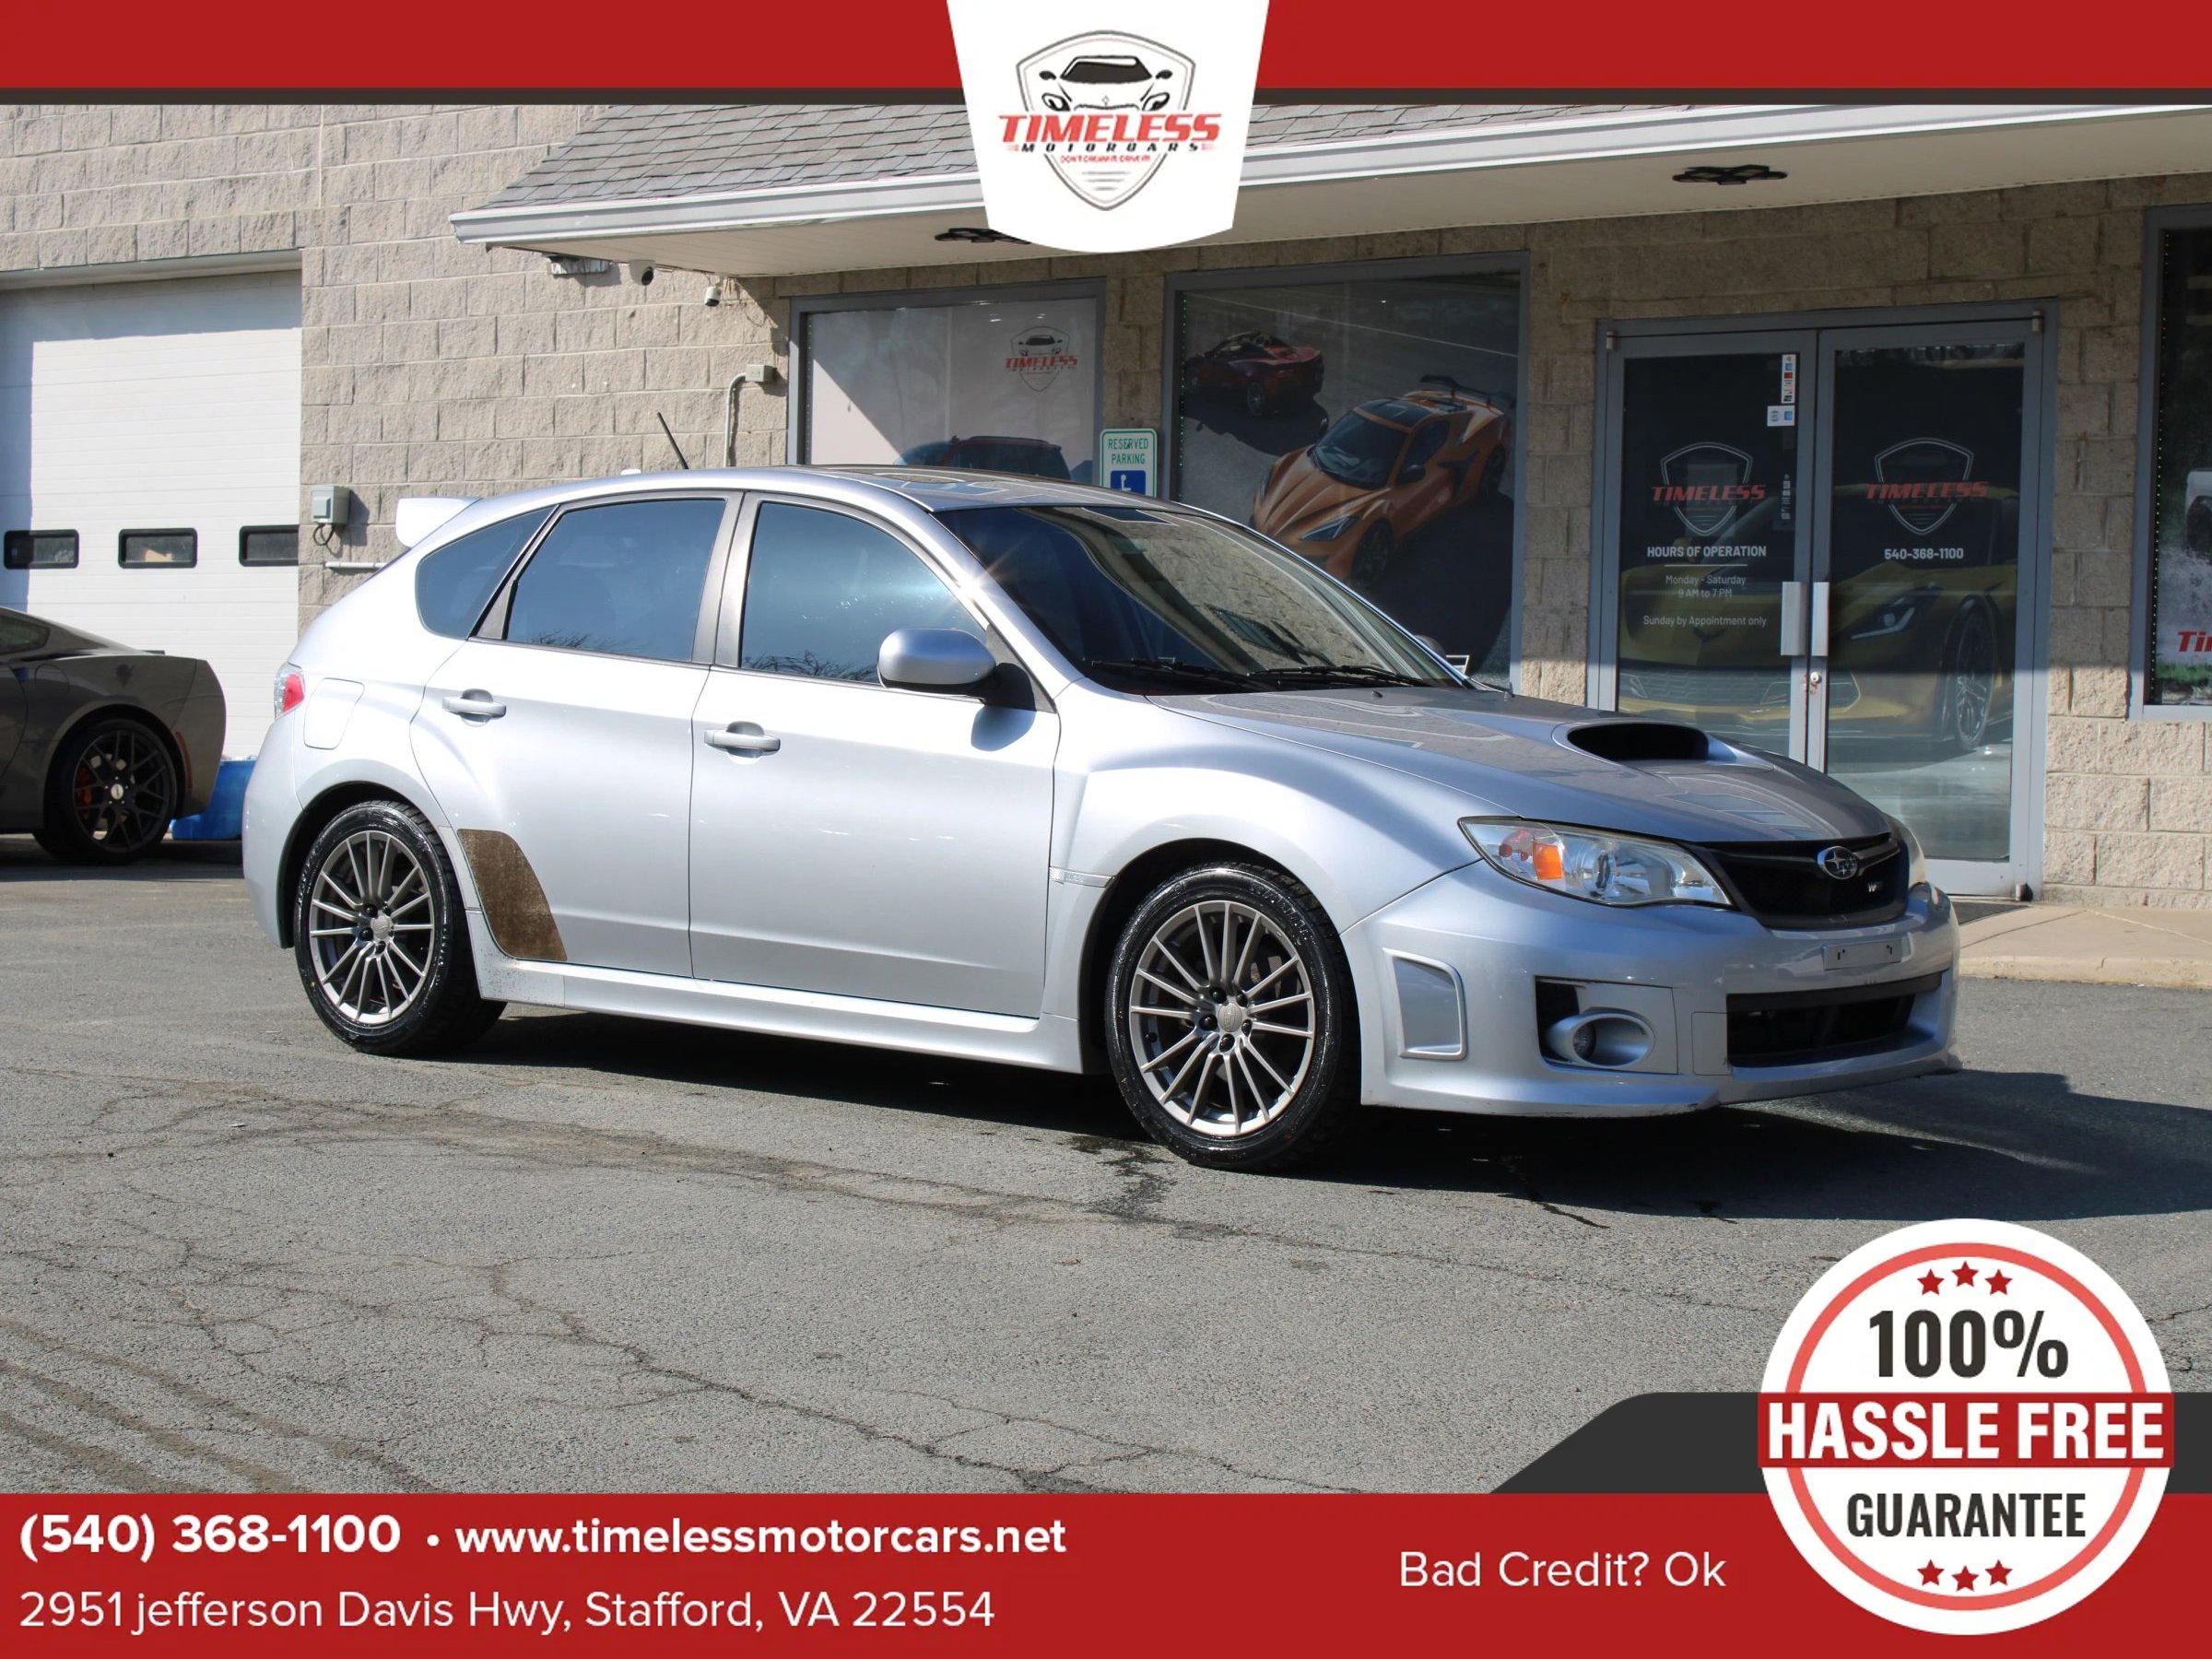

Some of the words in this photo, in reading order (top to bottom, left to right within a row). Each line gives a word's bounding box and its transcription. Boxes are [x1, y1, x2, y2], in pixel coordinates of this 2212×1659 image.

[1006, 355, 1077, 370] TIMELESS
[1108, 438, 1148, 450] RESERVED
[1112, 453, 1145, 465] PARKING
[1652, 484, 1766, 501] TIMELESS
[1866, 481, 1990, 500] TIMELESS
[1647, 546, 1684, 557] HOURS
[1687, 546, 1701, 557] OF
[1703, 545, 1767, 557] OPERATION
[1884, 547, 1964, 559] 540-368-1100
[1665, 575, 1698, 586] Monday
[1706, 574, 1747, 585] Saturday
[1686, 589, 1699, 598] AM
[1700, 589, 1711, 597] to
[1719, 588, 1733, 597] PM
[1642, 615, 1676, 627] Sunday
[1677, 616, 1687, 627] by
[1688, 616, 1747, 627] Appointment
[1748, 616, 1767, 627] only
